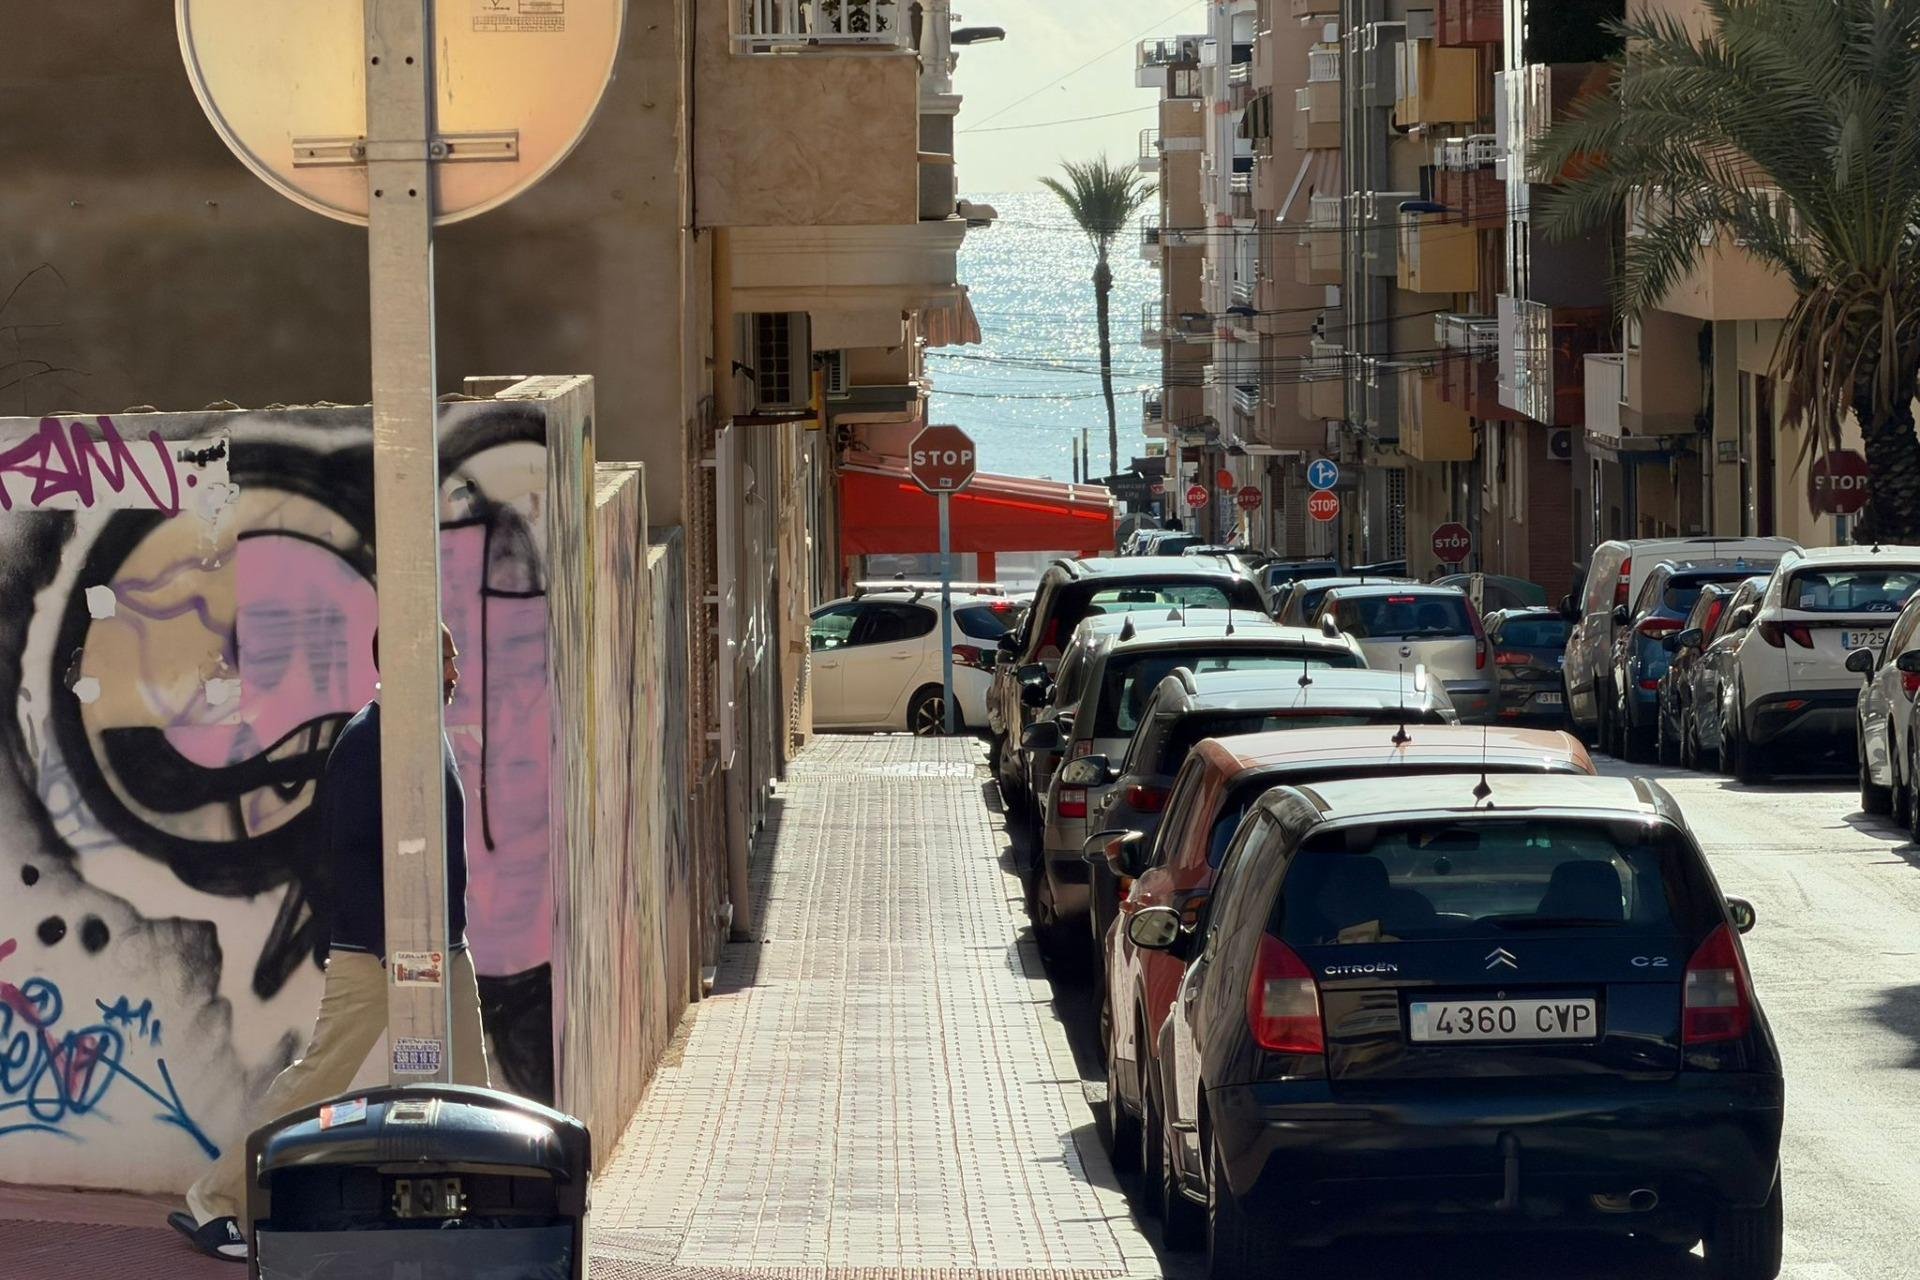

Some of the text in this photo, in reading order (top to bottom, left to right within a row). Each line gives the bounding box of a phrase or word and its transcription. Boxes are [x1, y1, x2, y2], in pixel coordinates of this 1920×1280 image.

[913, 450, 972, 466] STOP
[1310, 500, 1338, 512] STOP
[1435, 538, 1469, 549] STOP
[1851, 632, 1885, 645] 3725
[1324, 961, 1398, 974] CITROËN
[1631, 956, 1669, 967] C2
[1436, 1005, 1590, 1034] 4360 CVP
